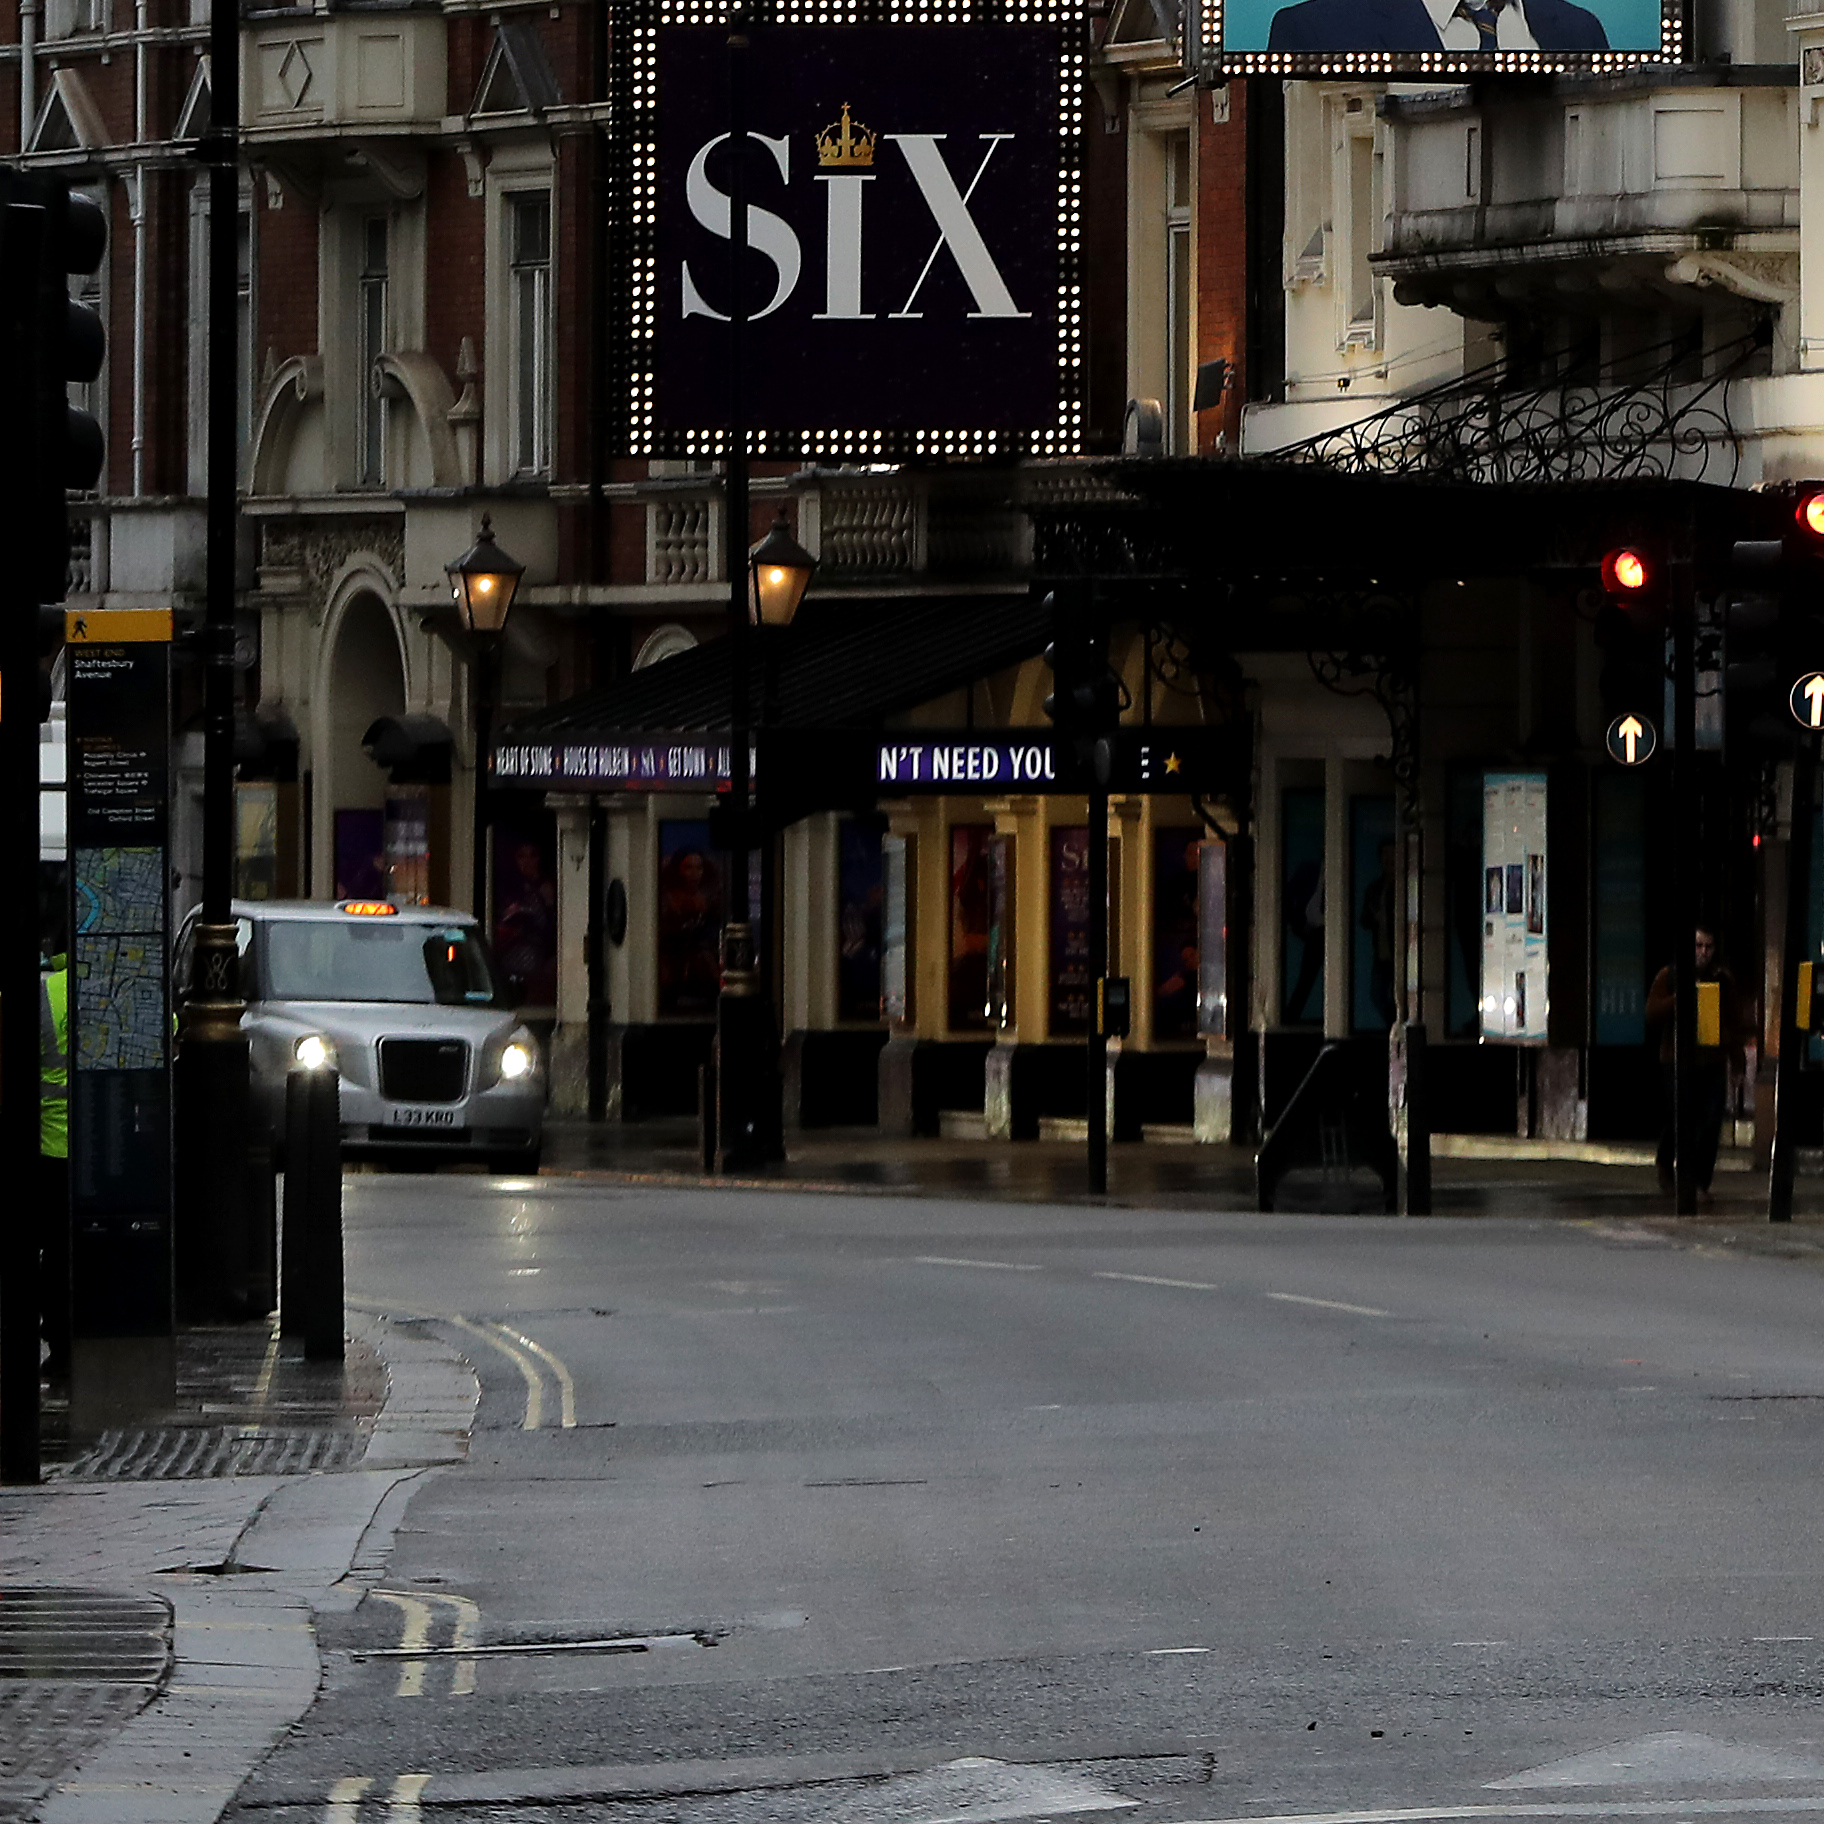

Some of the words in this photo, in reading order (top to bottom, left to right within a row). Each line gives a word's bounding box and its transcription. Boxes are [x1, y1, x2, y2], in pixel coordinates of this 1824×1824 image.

[682, 131, 1033, 322] SIX
[74, 659, 135, 670] Shaftesbury
[932, 746, 999, 781] NEED
